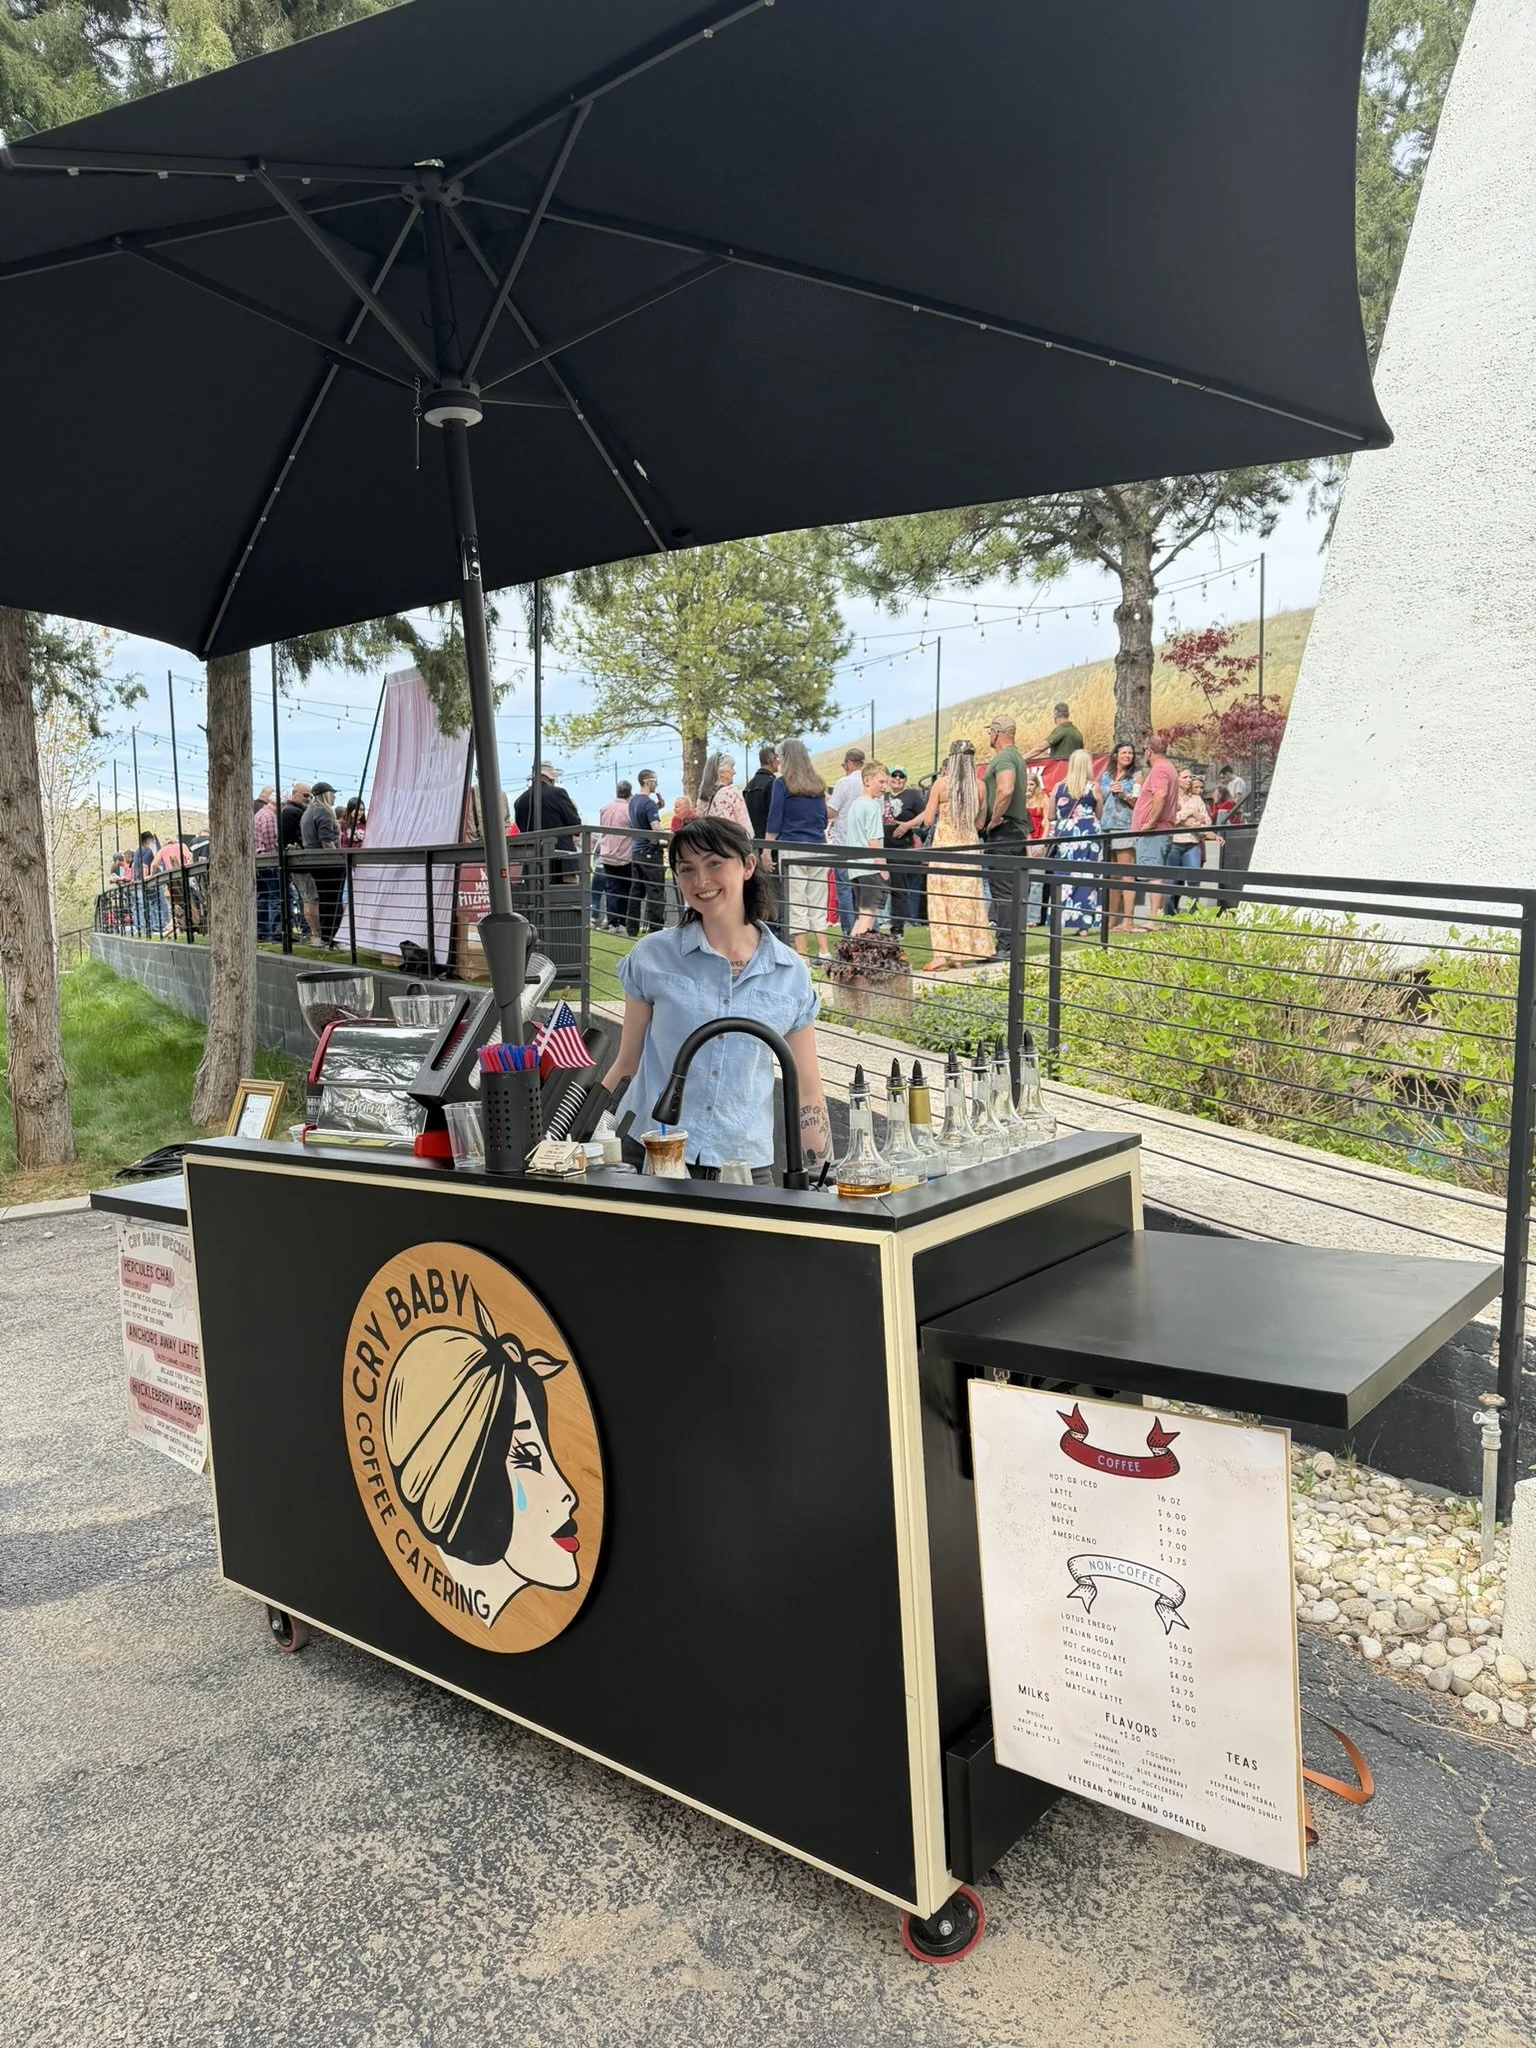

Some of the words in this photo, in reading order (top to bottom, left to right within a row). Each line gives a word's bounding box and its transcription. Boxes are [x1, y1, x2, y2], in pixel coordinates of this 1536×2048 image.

[458, 891, 491, 907] FITZPA
[129, 1232, 141, 1249] CRY
[142, 1232, 160, 1247] BABY
[124, 1259, 154, 1279] HERCULES
[155, 1267, 172, 1283] CHAI
[129, 1325, 158, 1346] ANCHORS
[160, 1335, 177, 1352] AWAY
[179, 1341, 199, 1360] LATTE
[352, 1311, 391, 1404] CRY
[385, 1268, 471, 1331] BABY
[132, 1380, 174, 1408] HUCKLEBERRY
[175, 1397, 202, 1420] HARBOR
[1097, 1454, 1141, 1472] COFFEE
[1049, 1472, 1063, 1482] HOT
[1067, 1476, 1077, 1485] OR
[1080, 1479, 1098, 1489] ICED
[1049, 1487, 1073, 1498] LATTE
[1157, 1494, 1166, 1503] 16
[1170, 1497, 1181, 1506] OZ
[355, 1411, 397, 1527] COFFEE
[394, 1528, 491, 1621] CATERING
[1050, 1501, 1078, 1513] MOCHA
[1051, 1514, 1075, 1527] BREVE
[1166, 1511, 1187, 1522] 6.00
[1052, 1529, 1097, 1545] AMERICANO
[1167, 1526, 1187, 1537] 6.50
[1168, 1541, 1187, 1552] 7.00
[1088, 1559, 1162, 1587] NON-COFFEE
[1060, 1612, 1084, 1624] LOTUS
[1087, 1619, 1117, 1633] ENERGY
[1062, 1626, 1091, 1640] ITALIAN
[1094, 1634, 1114, 1646] SODA
[1063, 1639, 1077, 1649] HOT
[1081, 1645, 1127, 1664] CHOCOLATE
[1169, 1641, 1193, 1654] $6.50
[1064, 1654, 1101, 1670] ASSORTED
[1105, 1665, 1123, 1677] TEAS
[1169, 1656, 1193, 1669] $3.75
[1064, 1667, 1083, 1678] CHAI
[1085, 1674, 1108, 1687] LATTE
[1170, 1671, 1194, 1684] $4.00
[1018, 1683, 1050, 1703] MILKS
[1065, 1681, 1097, 1696] MATCHA
[1100, 1692, 1123, 1705] LATTE
[1171, 1685, 1194, 1698] $3.75
[1171, 1700, 1197, 1714] $6.00
[1105, 1712, 1158, 1738] FLAVORS
[1172, 1714, 1197, 1728] $7.00
[1094, 1731, 1119, 1745] VANILLA
[1093, 1742, 1121, 1756] CARAMEL
[1145, 1749, 1176, 1764] COCONUT
[1090, 1750, 1126, 1768] CHOCOLATE
[1141, 1758, 1182, 1777] STRAWBERRY
[1226, 1751, 1258, 1771] TEAS
[1083, 1758, 1110, 1773] MEXICAN
[1112, 1767, 1134, 1781] MOCHA
[1136, 1767, 1151, 1777] BLUE
[1153, 1773, 1189, 1790] RASPBERRY
[1108, 1777, 1126, 1788] WHITE
[1128, 1784, 1164, 1802] CHOCOLATE
[1142, 1780, 1184, 1799] HUCKLEBERRY
[1224, 1773, 1241, 1785] EARL
[1243, 1780, 1261, 1791] GREY
[1067, 1773, 1137, 1806] VETERAN-OWNED
[1141, 1801, 1158, 1814] AND
[1162, 1809, 1207, 1833] OPERATED
[1210, 1779, 1250, 1798] PEPPERMINT
[1252, 1795, 1277, 1809] HERBAL
[1205, 1789, 1218, 1798] HOT
[1220, 1795, 1256, 1813] CINNAMON
[1258, 1808, 1283, 1822] SUNSET
